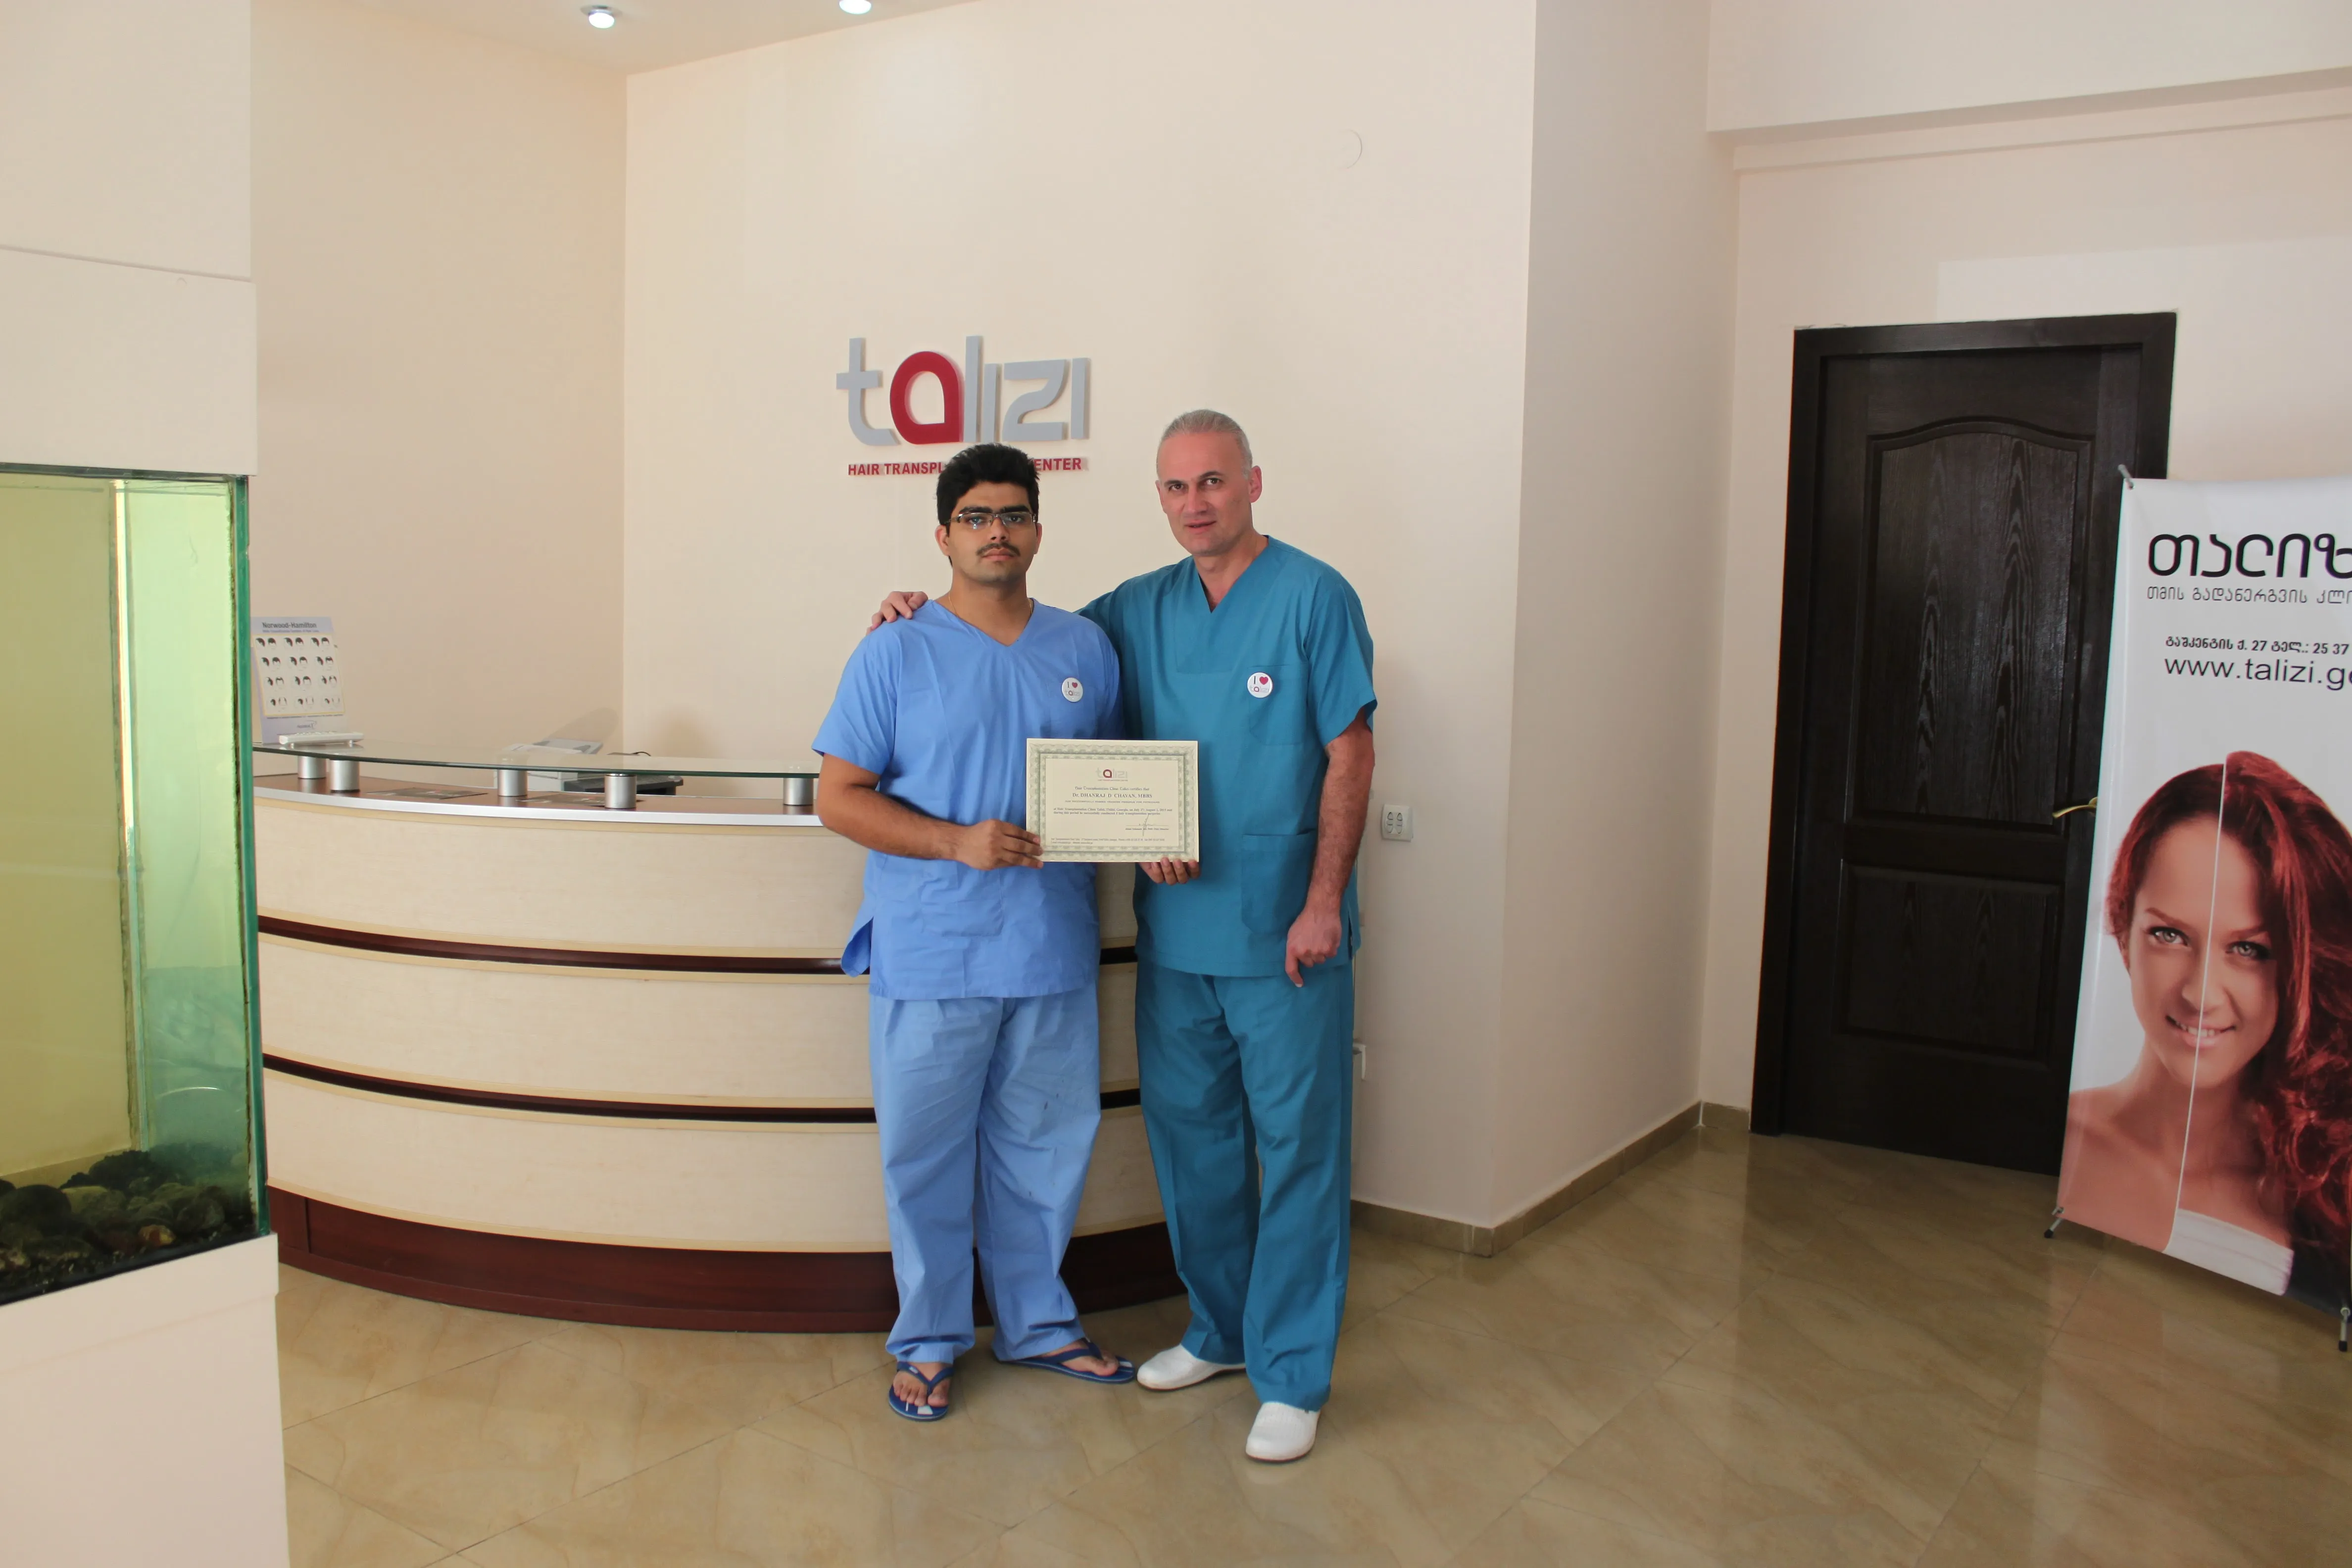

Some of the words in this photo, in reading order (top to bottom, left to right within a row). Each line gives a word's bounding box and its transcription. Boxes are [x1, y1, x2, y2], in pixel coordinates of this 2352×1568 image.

[836, 335, 1089, 445] talizi
[848, 463, 880, 476] HAIR
[884, 462, 943, 475] TRANSPL
[1033, 458, 1081, 471] ENTER
[2147, 586, 2184, 600] თმის
[2192, 587, 2307, 603] გადანერგვის
[2165, 636, 2233, 650] ტაშკენტის
[2251, 640, 2267, 651] 27
[2312, 643, 2328, 654] 25
[2332, 643, 2349, 655] 37
[2164, 658, 2352, 690] www.talizi.g
